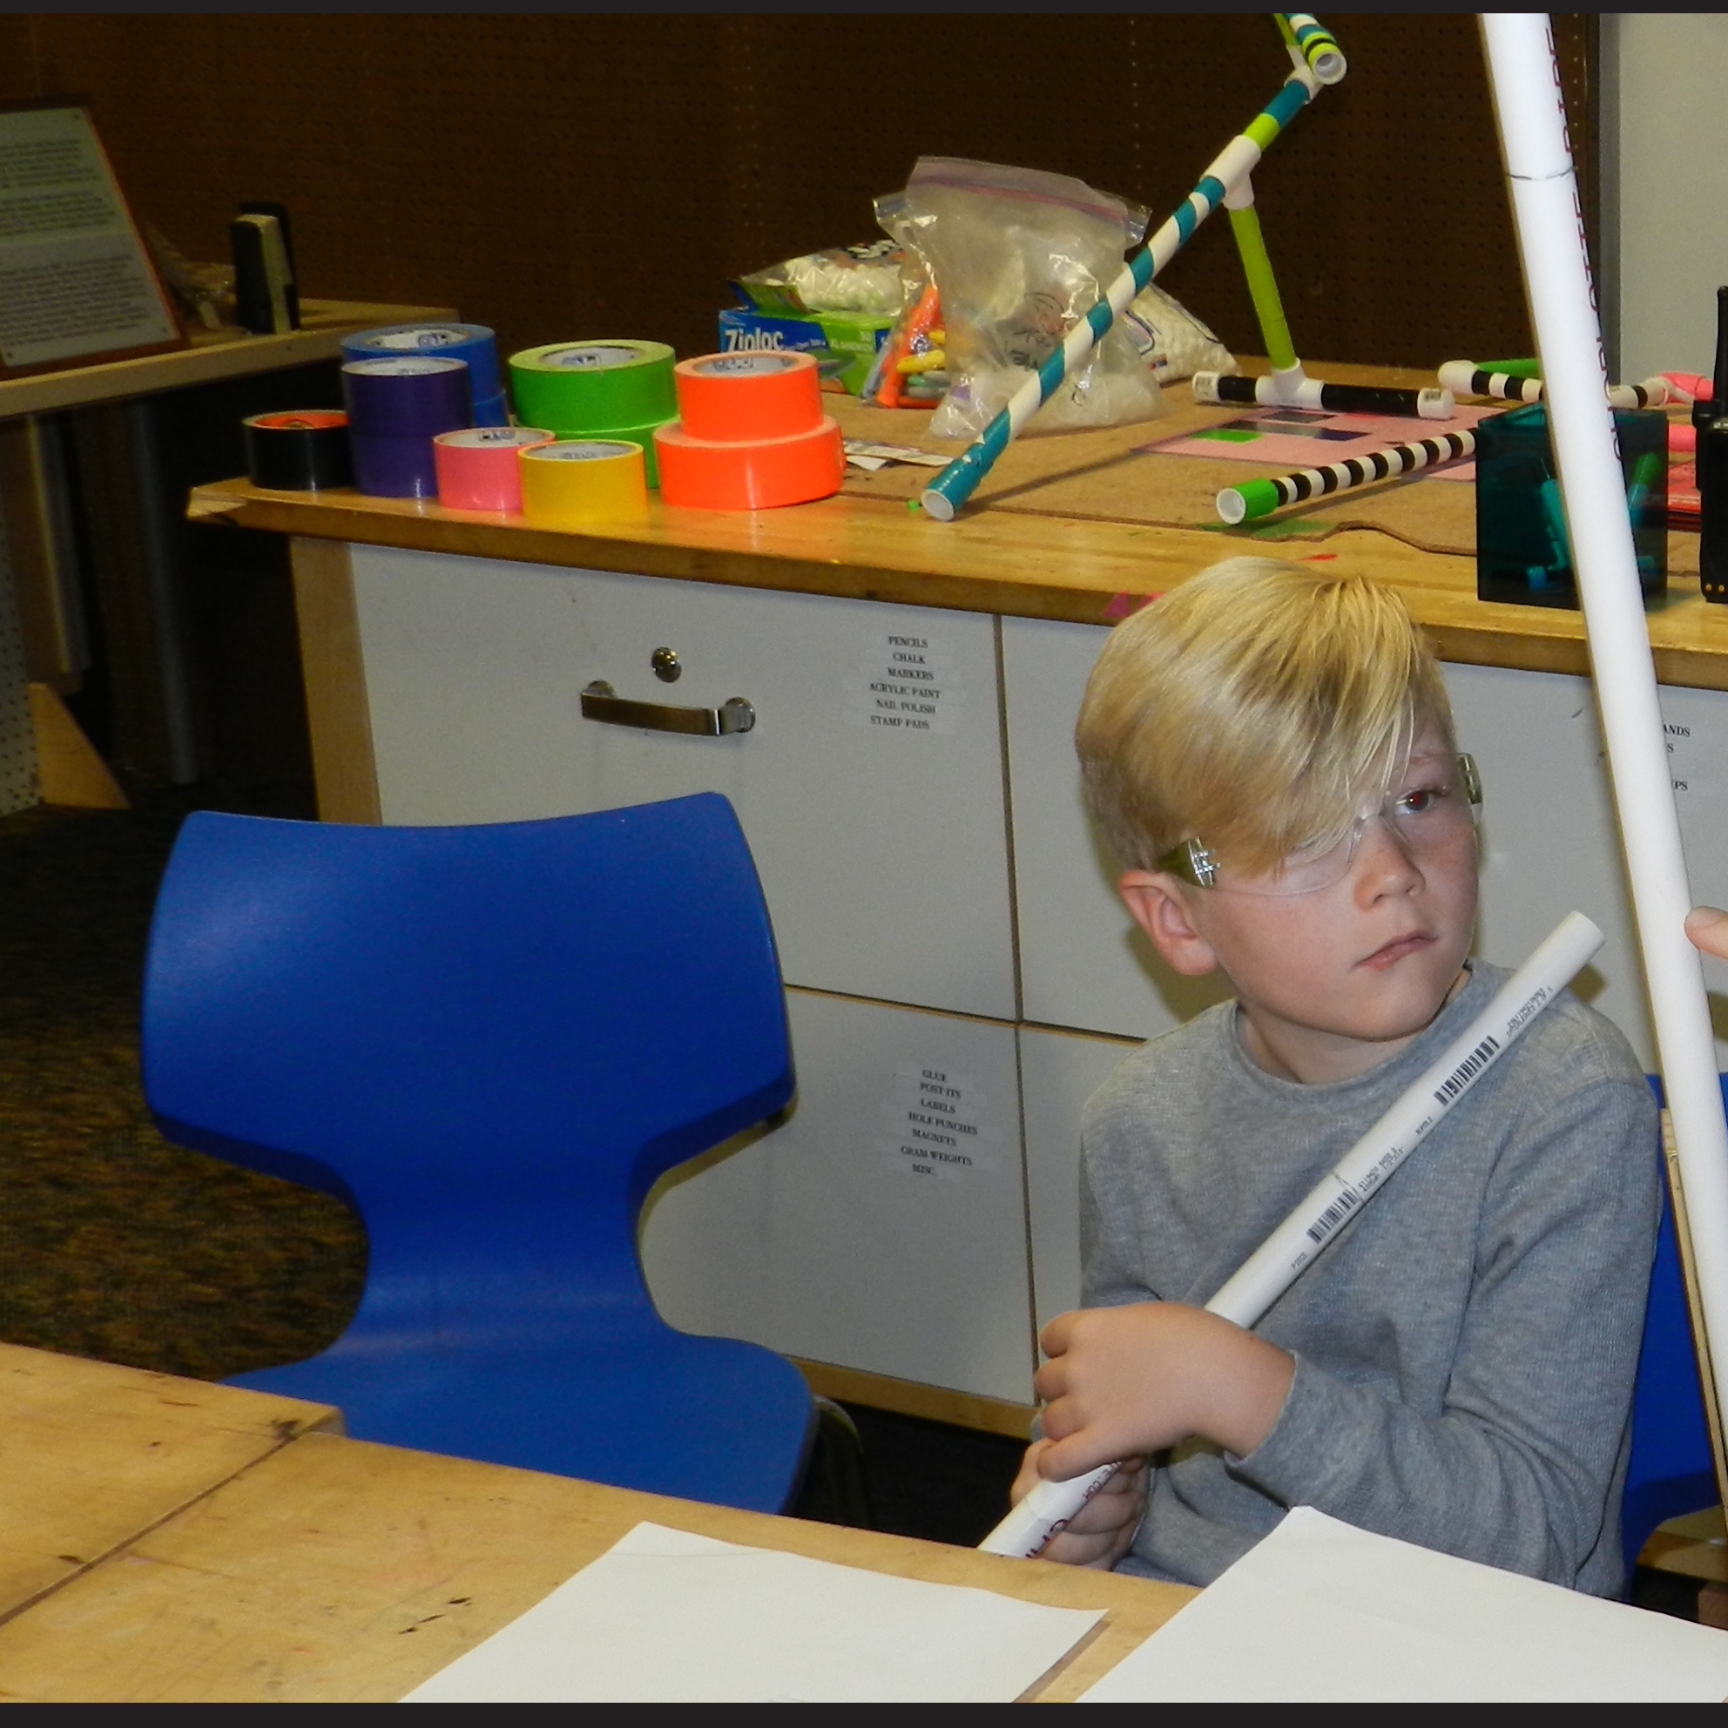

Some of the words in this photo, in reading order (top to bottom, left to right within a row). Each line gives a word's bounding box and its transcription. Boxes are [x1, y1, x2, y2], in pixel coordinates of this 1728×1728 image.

[725, 327, 784, 352] Ziploc
[888, 636, 928, 648] PENCILS
[893, 652, 926, 664] CHALK
[887, 667, 934, 680] MARKERS
[869, 682, 910, 695] ACRYLIC
[912, 686, 941, 698] PAINT
[876, 699, 899, 710] NAIL
[901, 701, 936, 714] POLISH
[870, 714, 903, 726] STAMP
[905, 718, 930, 729] PADS
[922, 1069, 947, 1082] GLUE
[920, 1081, 944, 1095] POST
[946, 1087, 962, 1099] ITS
[920, 1098, 956, 1114] LABELS
[908, 1111, 933, 1124] HOLE
[935, 1117, 979, 1135] PUNCHES
[912, 1127, 957, 1146] MAGNETS
[901, 1145, 929, 1158] GRAM
[930, 1149, 973, 1166] WEIGHTS
